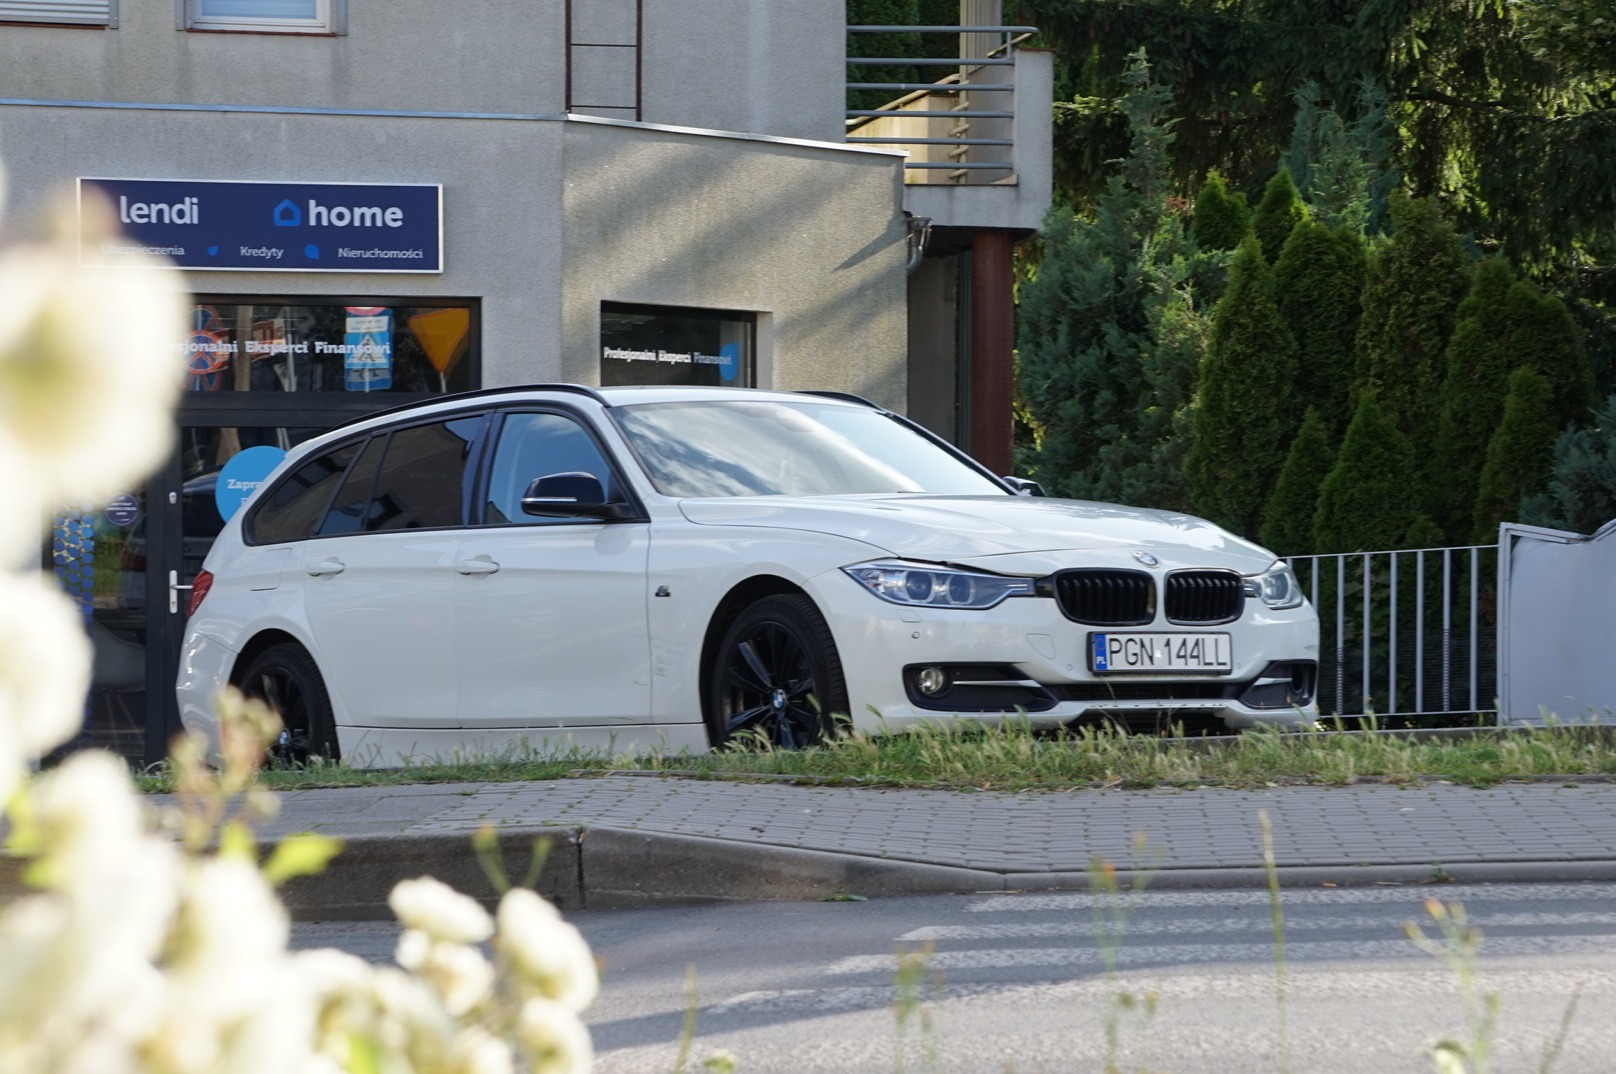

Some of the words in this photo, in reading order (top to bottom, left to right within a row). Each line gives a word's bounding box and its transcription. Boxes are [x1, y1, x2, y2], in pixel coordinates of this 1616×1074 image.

[120, 195, 199, 225] lendi
[308, 199, 404, 228] home
[240, 246, 285, 260] Kredyty
[338, 246, 424, 260] Nieruchomości
[245, 341, 309, 355] Eksperci
[314, 341, 391, 355] Finansowi
[658, 350, 692, 365] Eksperci
[693, 352, 733, 365] Finansowi
[1108, 637, 1154, 666] PGN
[1164, 637, 1228, 666] 144LL
[1095, 656, 1106, 665] PL
